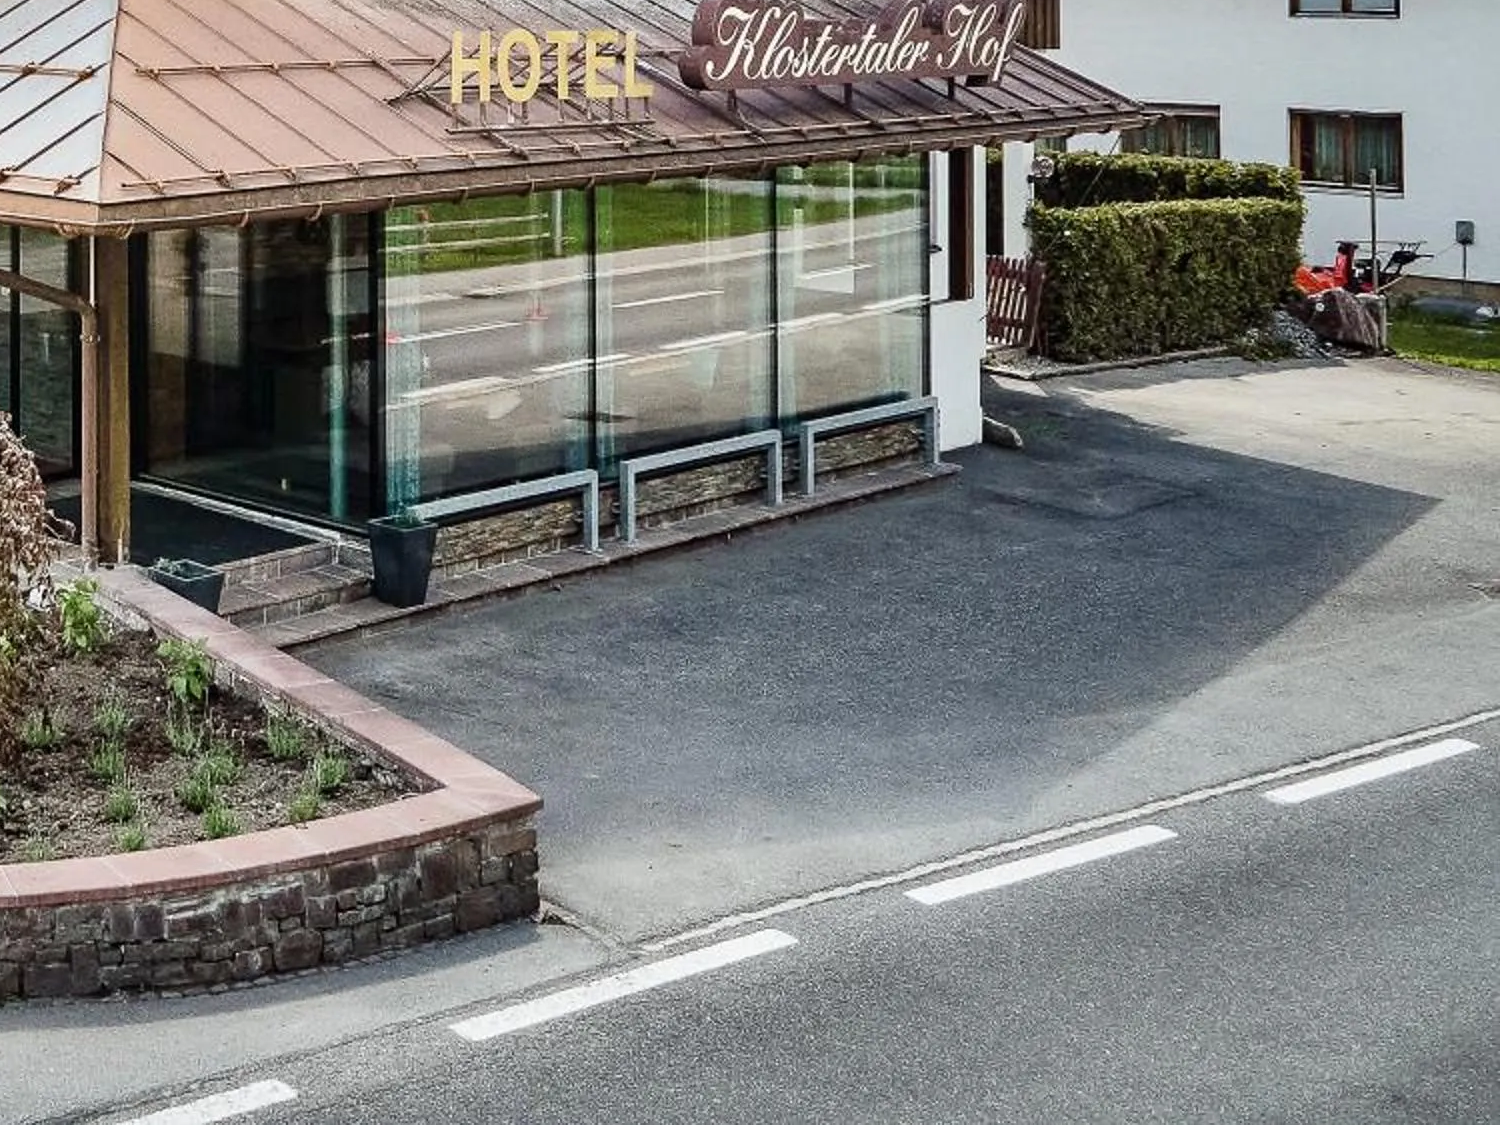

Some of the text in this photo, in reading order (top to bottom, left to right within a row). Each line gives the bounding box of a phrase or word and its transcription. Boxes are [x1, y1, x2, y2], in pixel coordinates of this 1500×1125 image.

[451, 28, 654, 104] HOTEL
[706, 2, 1025, 82] Klostertaler Hof
